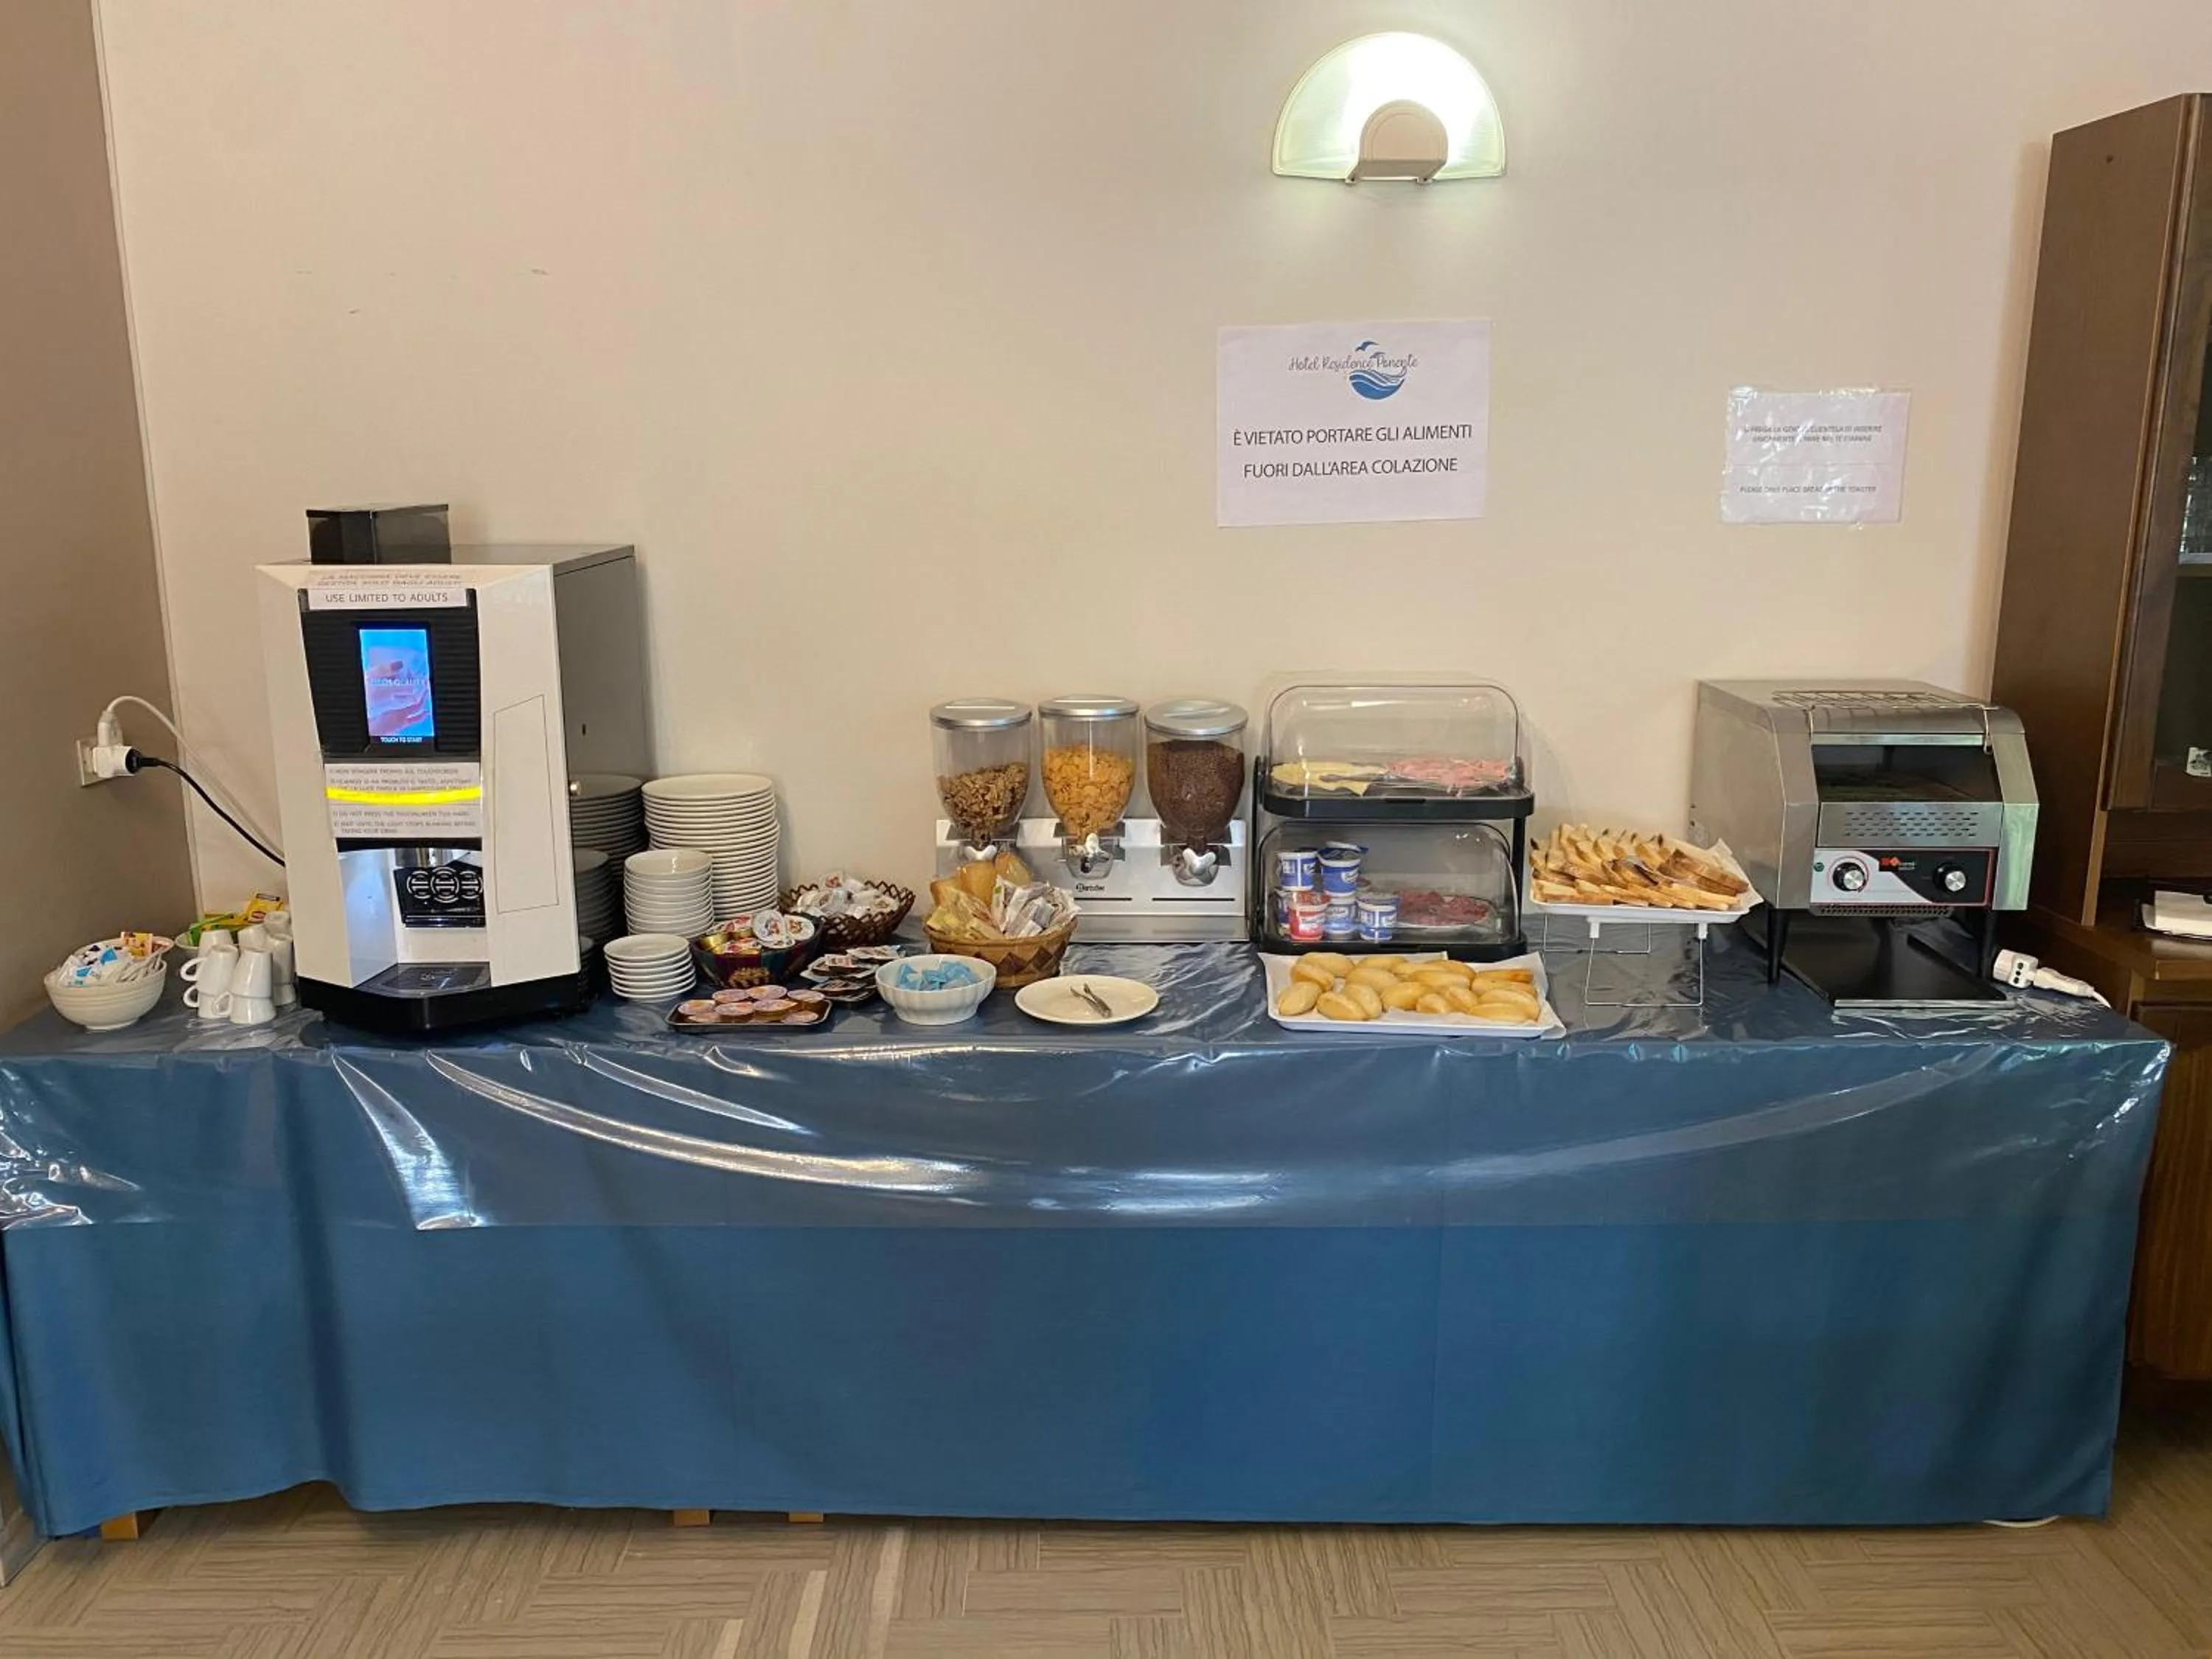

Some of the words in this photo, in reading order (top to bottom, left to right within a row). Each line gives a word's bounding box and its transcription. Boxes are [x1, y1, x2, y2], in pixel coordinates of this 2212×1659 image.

[1288, 355, 1320, 370] Hotel
[1245, 428, 1304, 446] VIETATO
[1307, 427, 1372, 444] PORTARE
[1376, 425, 1399, 442] GLI
[1403, 424, 1472, 441] ALIMENTI
[1244, 462, 1288, 479] FUORI
[1293, 460, 1368, 478] DALL'AREA
[1371, 458, 1458, 474] COLAZIONE
[325, 594, 345, 603] USE
[349, 594, 389, 603] LIMITED
[392, 593, 406, 602] TO
[410, 592, 448, 602] ADULTS
